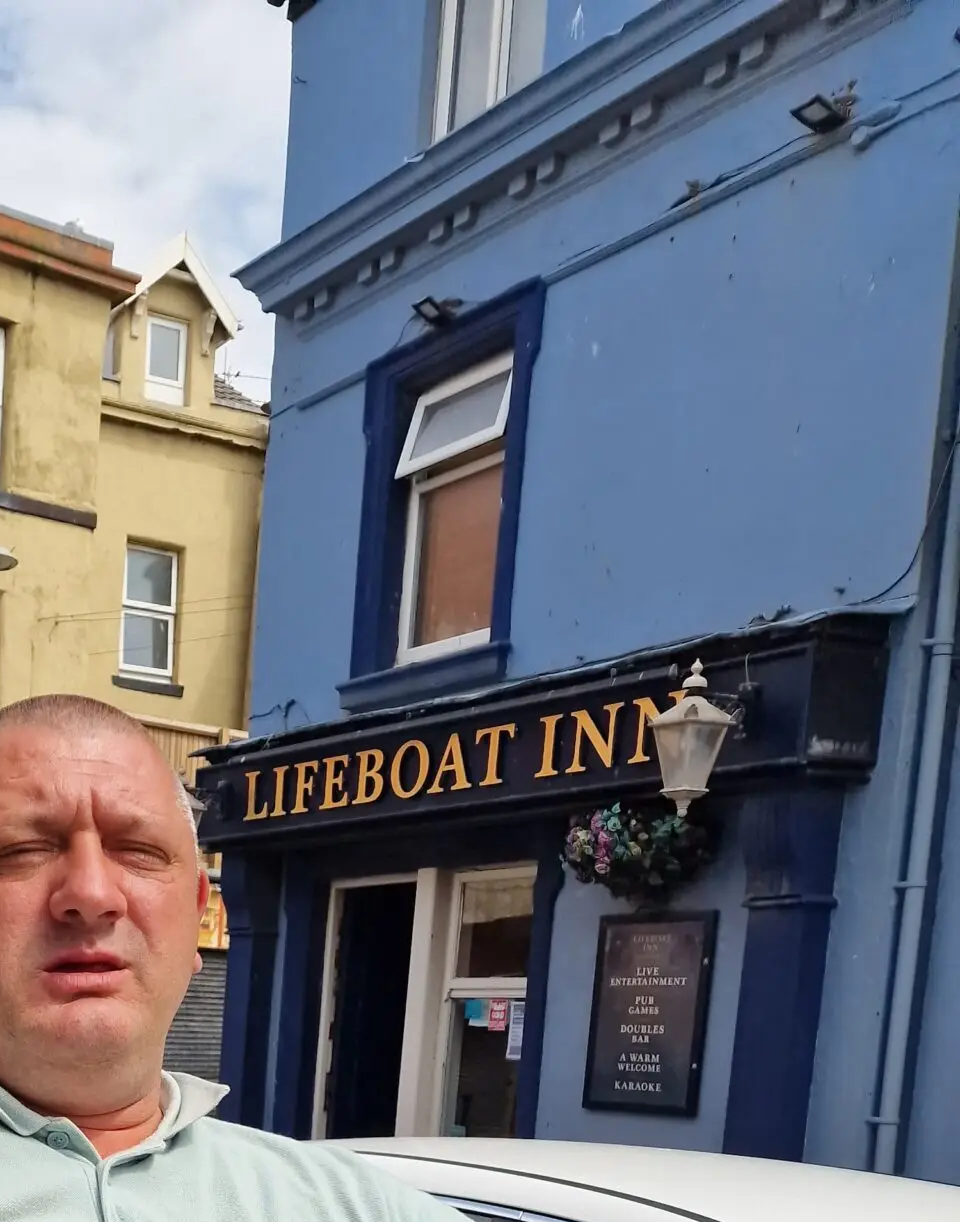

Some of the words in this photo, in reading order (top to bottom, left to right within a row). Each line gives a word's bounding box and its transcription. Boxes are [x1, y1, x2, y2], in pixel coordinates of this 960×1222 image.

[243, 722, 516, 821] LIFEBOAT
[636, 967, 659, 976] LIVE
[610, 977, 687, 986] ENTERTAINMENT
[635, 996, 654, 1005] PUB
[628, 1006, 659, 1015] GAMES
[620, 1024, 665, 1034] DOUBLES
[632, 1035, 649, 1043] BAR
[620, 1053, 626, 1062] A
[630, 1053, 660, 1063] WARM
[617, 1063, 661, 1073] WELCOME
[614, 1080, 662, 1092] KARAOKE
